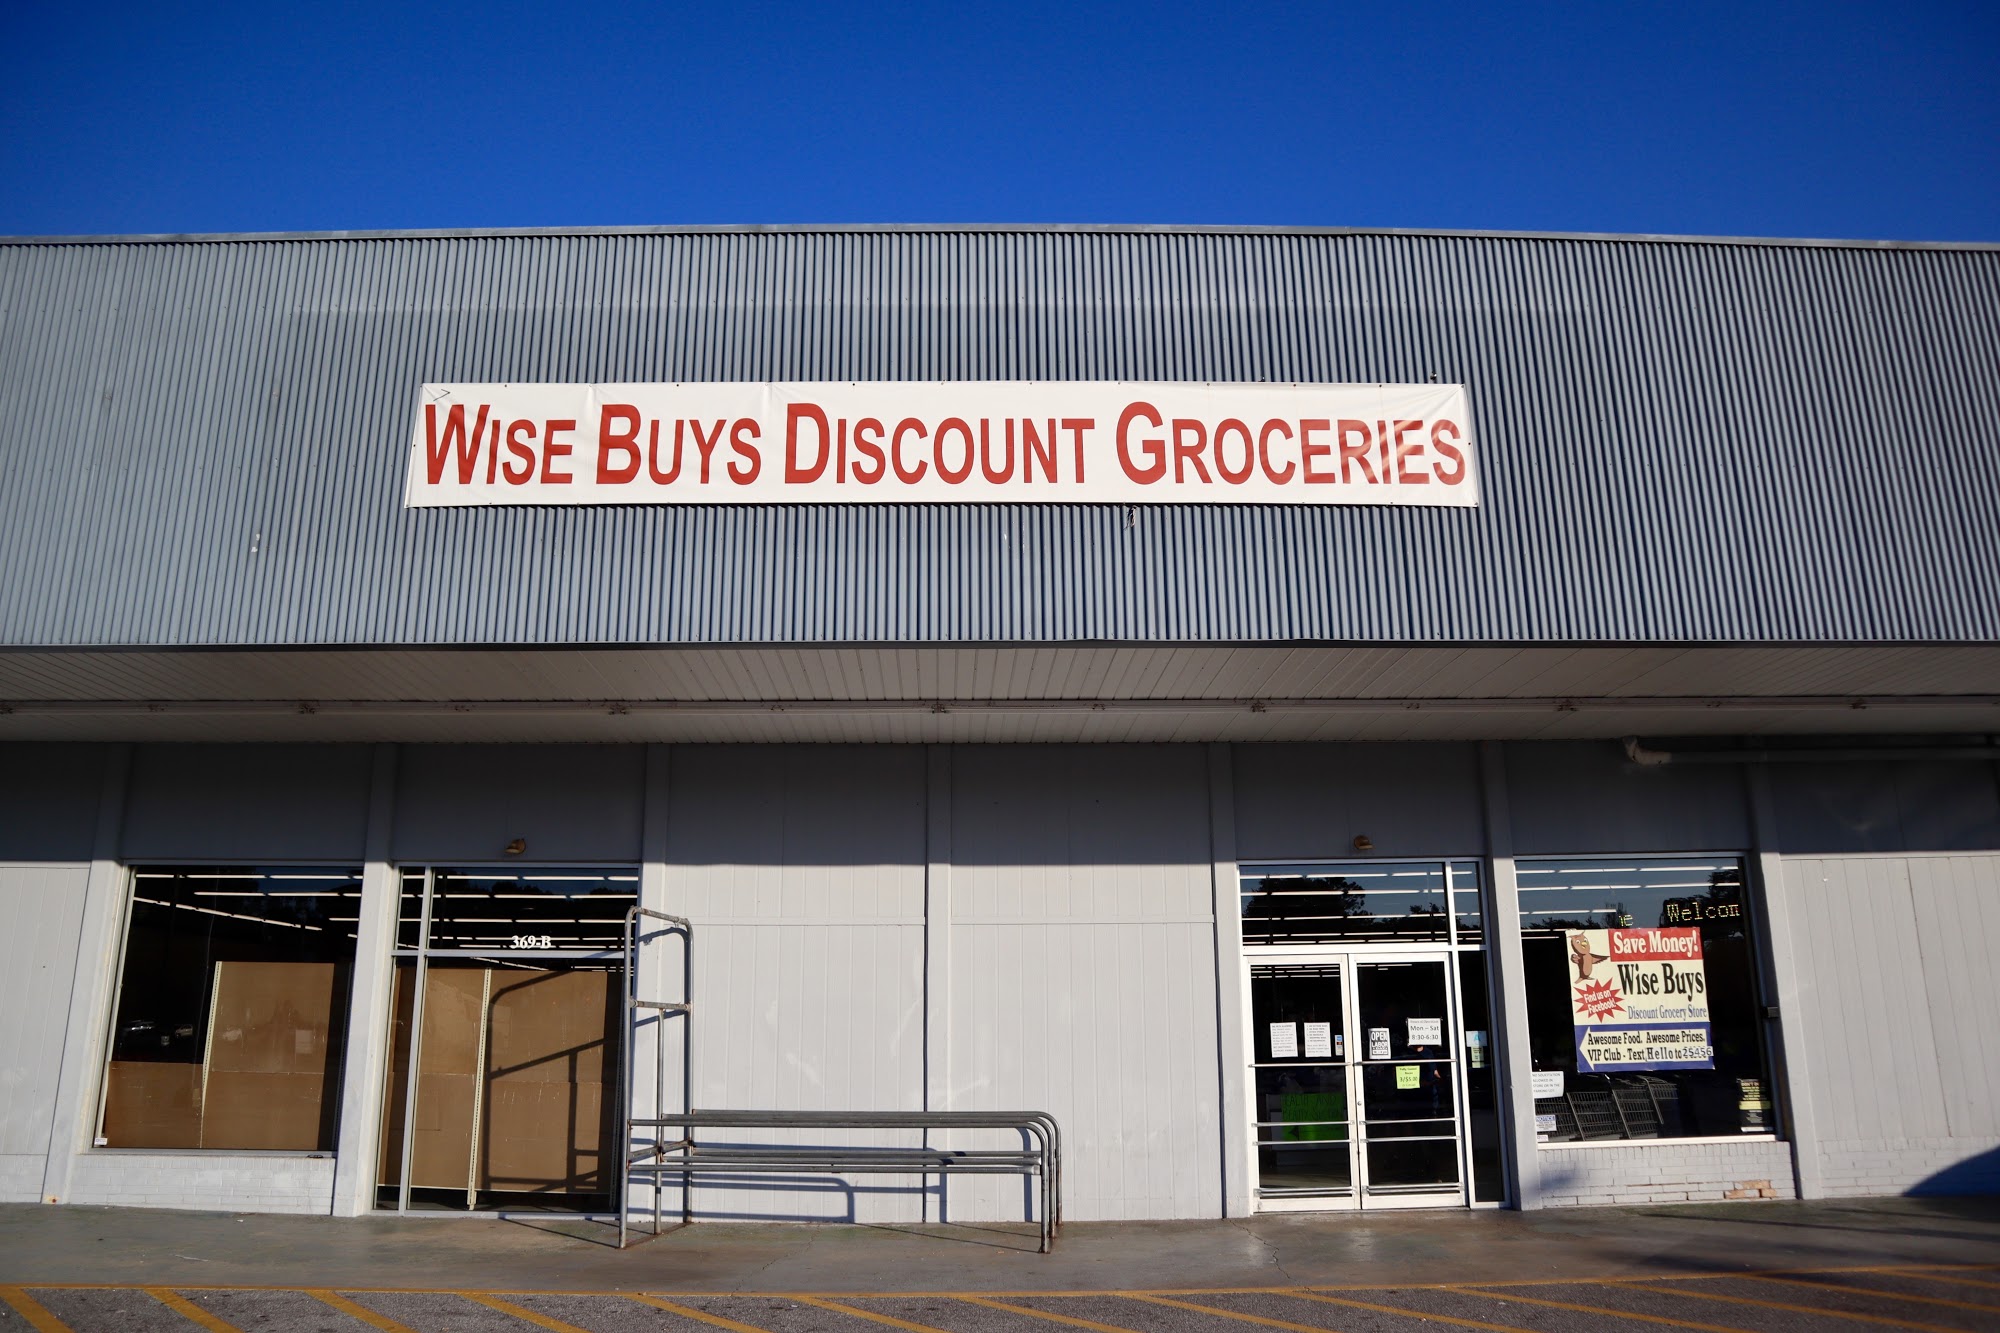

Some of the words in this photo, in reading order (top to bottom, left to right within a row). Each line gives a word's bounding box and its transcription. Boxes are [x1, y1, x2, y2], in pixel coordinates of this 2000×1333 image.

[424, 403, 576, 486] WISE
[596, 403, 762, 486] BUYS
[784, 402, 1096, 486] DISCOUNT
[1116, 401, 1467, 486] GROCERIES
[511, 935, 552, 949] 369-B
[1613, 931, 1647, 954] Save
[1648, 929, 1699, 958] Money!
[1617, 963, 1660, 996] Wise
[1661, 962, 1704, 1002] Buys
[1583, 991, 1597, 1003] Find
[1604, 989, 1611, 998] on
[1587, 997, 1617, 1014] Facebook!
[1627, 1005, 1659, 1020] Discount
[1659, 1004, 1686, 1021] Grocery
[1687, 1003, 1707, 1018] Store
[1371, 1031, 1388, 1041] OPEN
[1587, 1033, 1622, 1046] Awesome
[1623, 1032, 1643, 1045] Food.
[1646, 1031, 1681, 1044] Awesome
[1681, 1030, 1706, 1043] Prices.
[1587, 1049, 1602, 1062] VIP
[1603, 1048, 1621, 1061] Club
[1646, 1047, 1674, 1060] Hello
[1674, 1048, 1682, 1059] to
[1682, 1047, 1712, 1058] 25456
